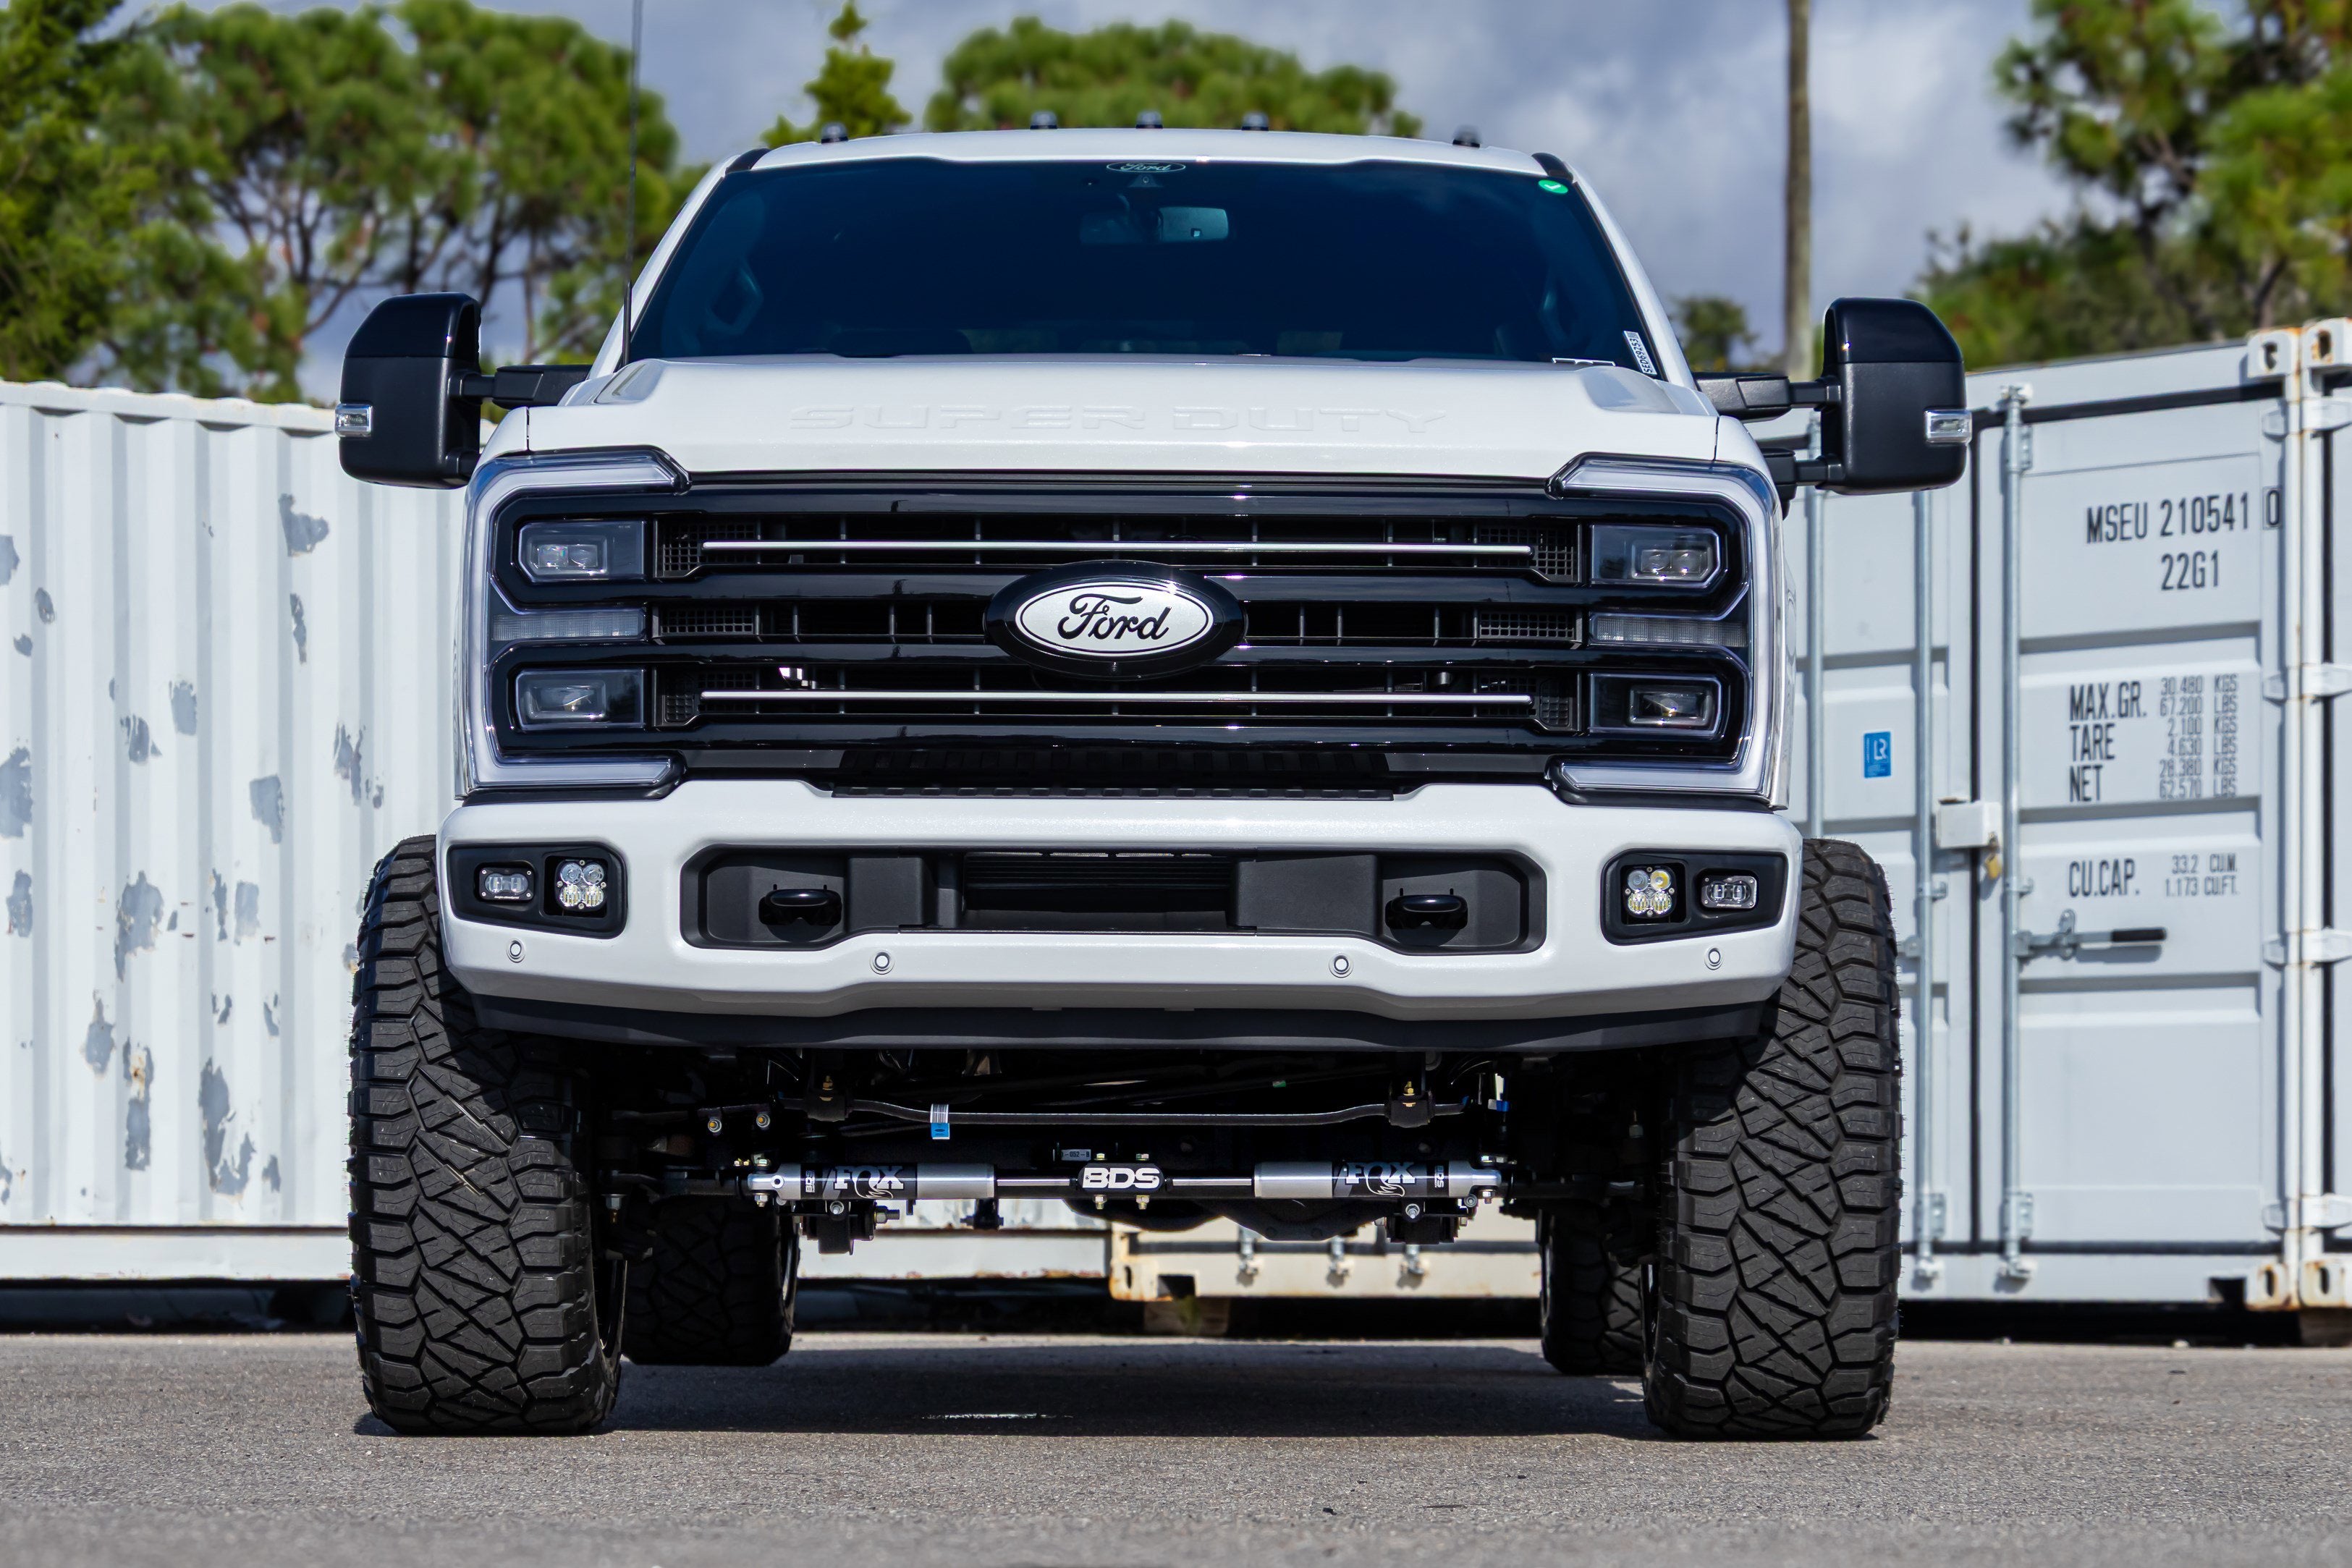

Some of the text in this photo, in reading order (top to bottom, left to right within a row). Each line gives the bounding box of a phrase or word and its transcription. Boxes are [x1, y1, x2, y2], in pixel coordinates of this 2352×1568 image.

[790, 404, 1447, 433] SUPER DUTY
[2086, 502, 2148, 543] MSEU
[2159, 491, 2249, 538] 210541
[2161, 550, 2219, 590] 22G1
[1057, 593, 1172, 640] Ford
[2069, 680, 2147, 721] MAX.GR.
[2214, 674, 2237, 692] KGS
[2159, 694, 2237, 716] 67.200 LBS
[2069, 715, 2237, 761] TARE 2.100 KGS
[2214, 736, 2237, 754] LBS
[2069, 764, 2103, 802] NET
[2214, 757, 2237, 775] KGS
[2213, 776, 2237, 797] LBS
[2069, 858, 2140, 898] CU.CAP.
[2172, 855, 2199, 874] 33.2
[2165, 876, 2199, 897] 1.173
[834, 1165, 904, 1195] FOX
[1083, 1167, 1160, 1189] BDS
[1345, 1161, 1416, 1194] FOX
